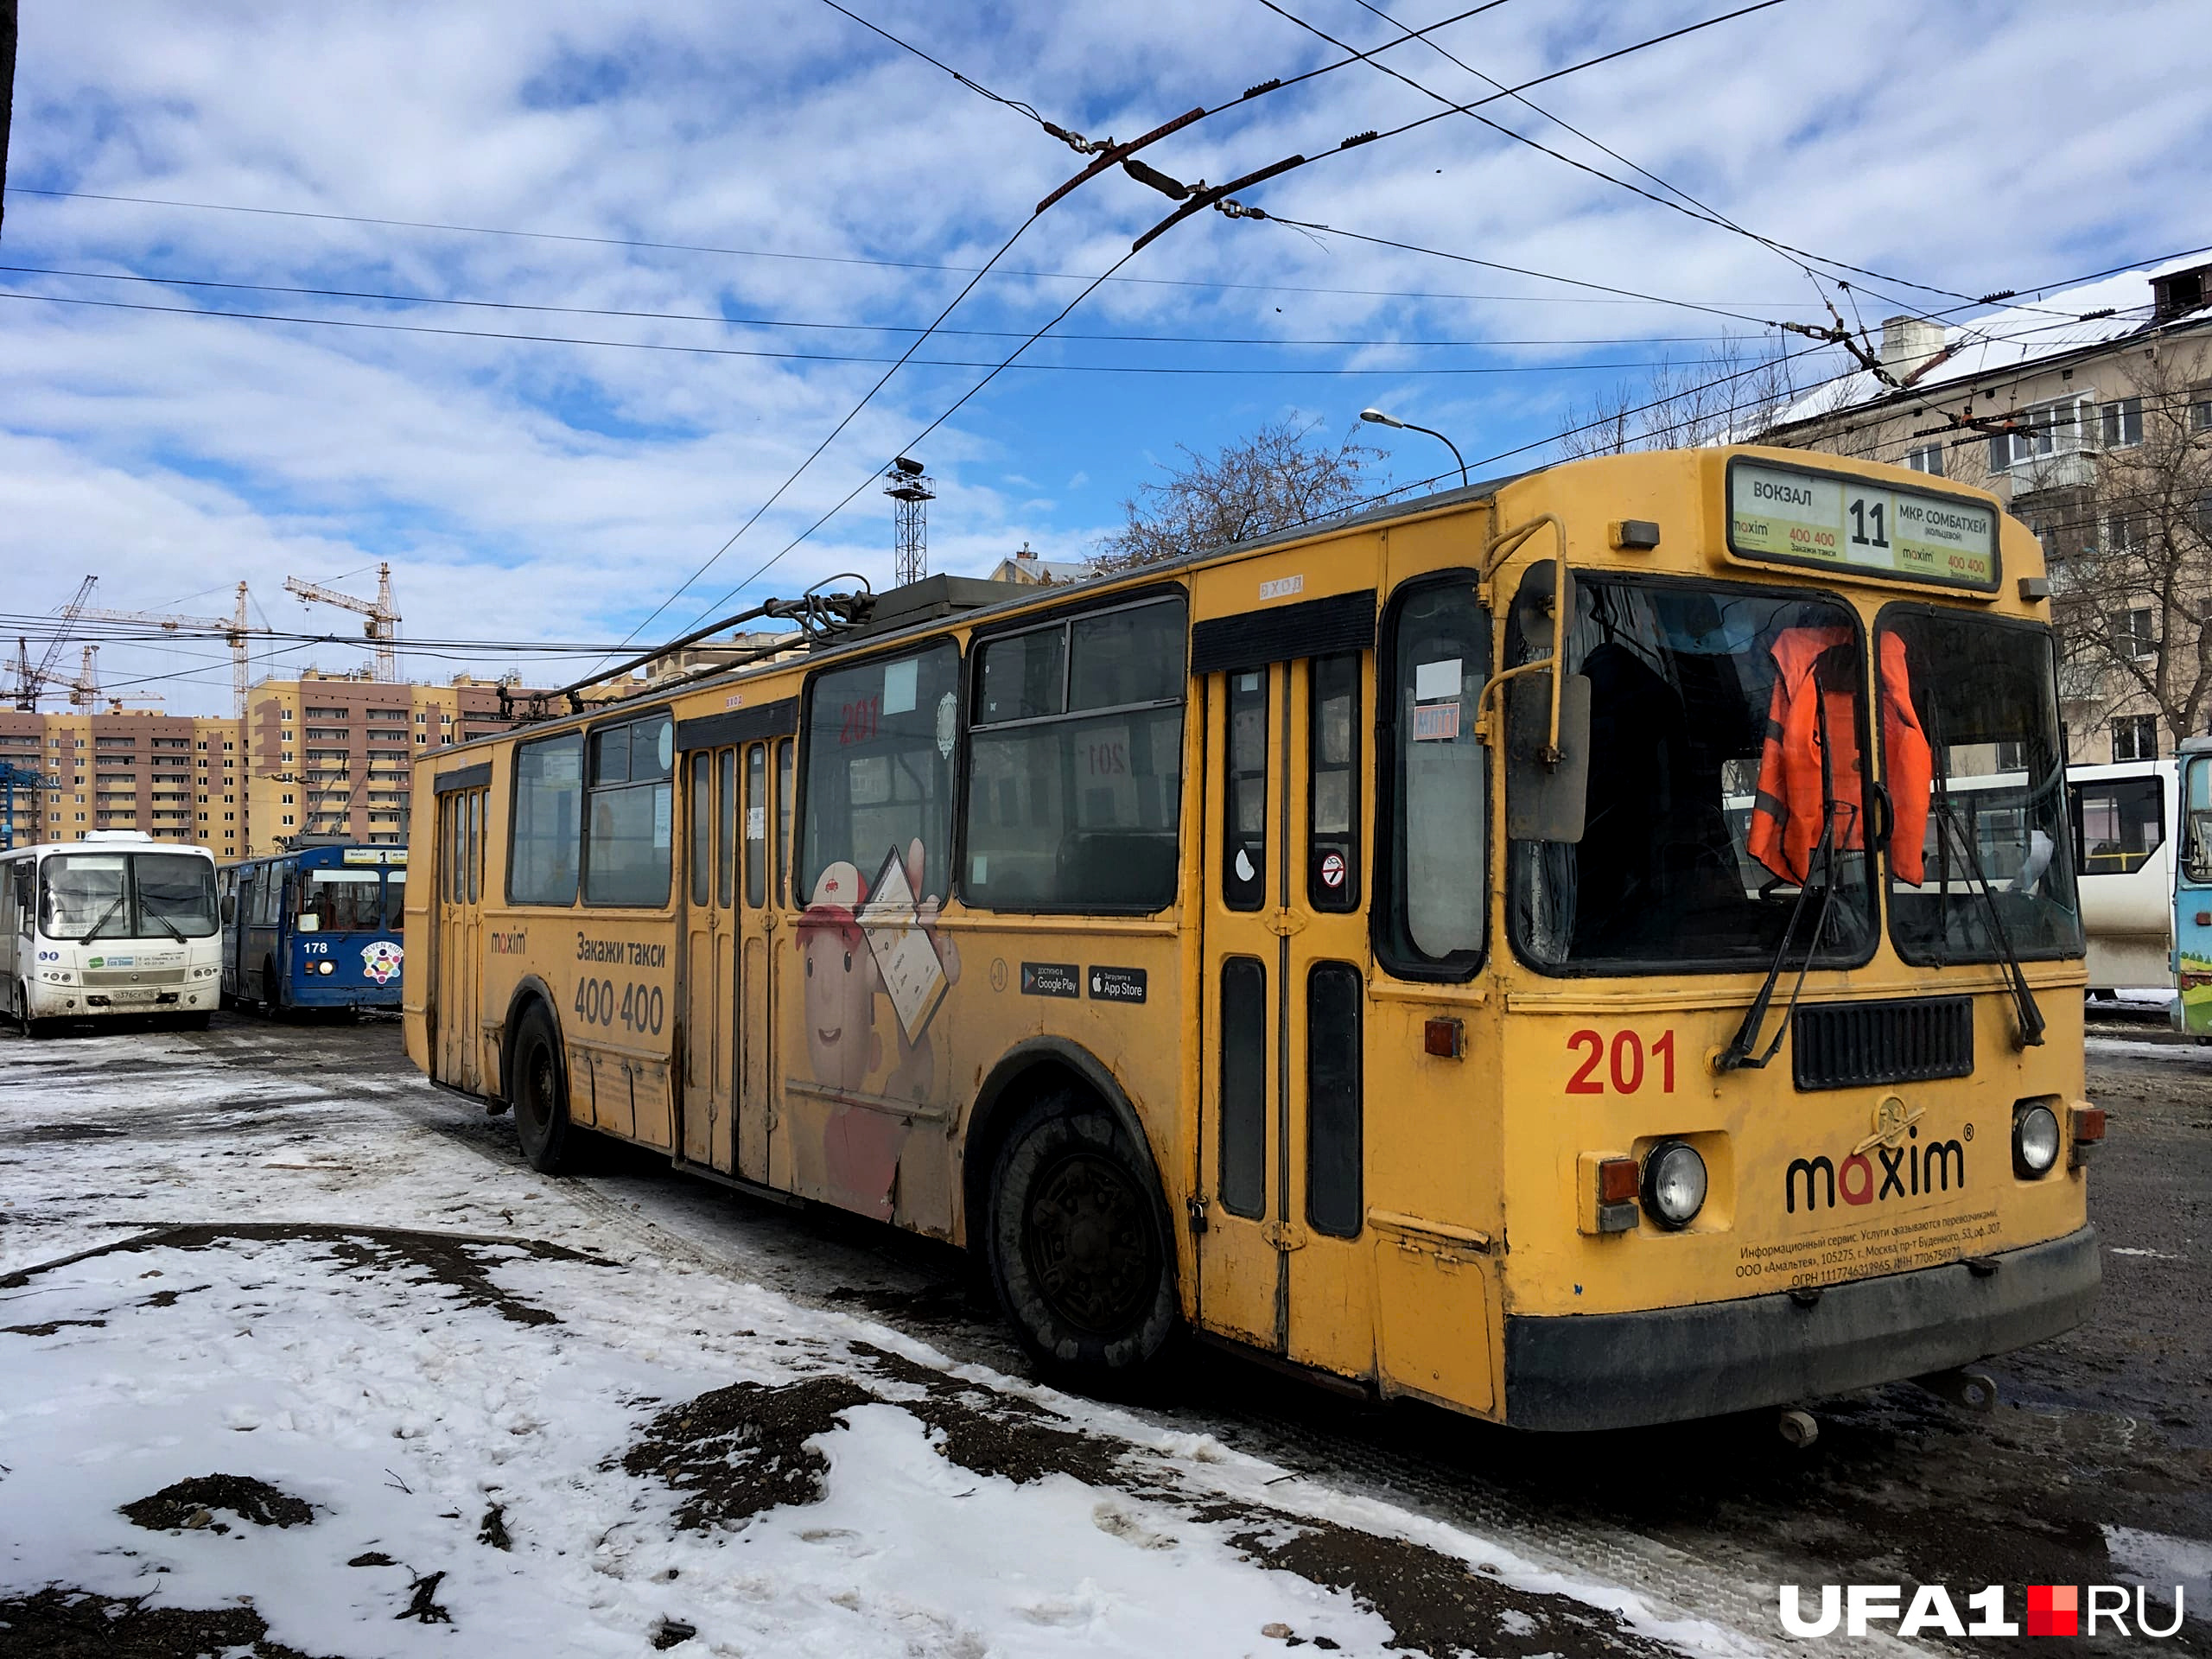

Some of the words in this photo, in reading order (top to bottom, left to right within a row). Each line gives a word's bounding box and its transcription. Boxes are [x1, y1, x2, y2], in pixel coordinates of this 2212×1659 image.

[1754, 481, 1812, 505] ВОКЗАЛ
[1849, 499, 1889, 549] 11
[1900, 505, 1924, 522] МКР.
[1926, 510, 1986, 534] СОМБАТХЕЙ
[1789, 527, 1811, 543] 400
[1815, 532, 1834, 547] 400
[1790, 543, 1816, 554] Закажи
[1818, 548, 1836, 557] такси
[1948, 555, 1965, 569] 400
[1967, 559, 1984, 573] 400
[839, 696, 878, 744] 201
[379, 851, 387, 863] 1
[303, 942, 327, 954] 178
[363, 942, 386, 956] SEVEN
[388, 944, 404, 957] KIDS
[576, 931, 624, 964] Закажи
[627, 942, 666, 968] такси
[1038, 976, 1062, 992] Google
[1062, 978, 1077, 993] Play
[1104, 973, 1127, 982] Загрузите
[1104, 982, 1121, 996] App
[1122, 982, 1142, 996] Store
[575, 976, 613, 1027] 400
[620, 982, 664, 1035] 400
[1565, 1029, 1675, 1095] 201
[1740, 1236, 1826, 1259] Информационный
[1860, 1228, 1890, 1242] Услуги
[1891, 1218, 1941, 1236] оказываются
[1735, 1264, 1762, 1278] ООО
[1821, 1248, 1856, 1264] 105275,
[1900, 1240, 1916, 1253] пр-т
[1918, 1232, 1960, 1249] Буденного,
[1791, 1271, 1818, 1287] ОГРН
